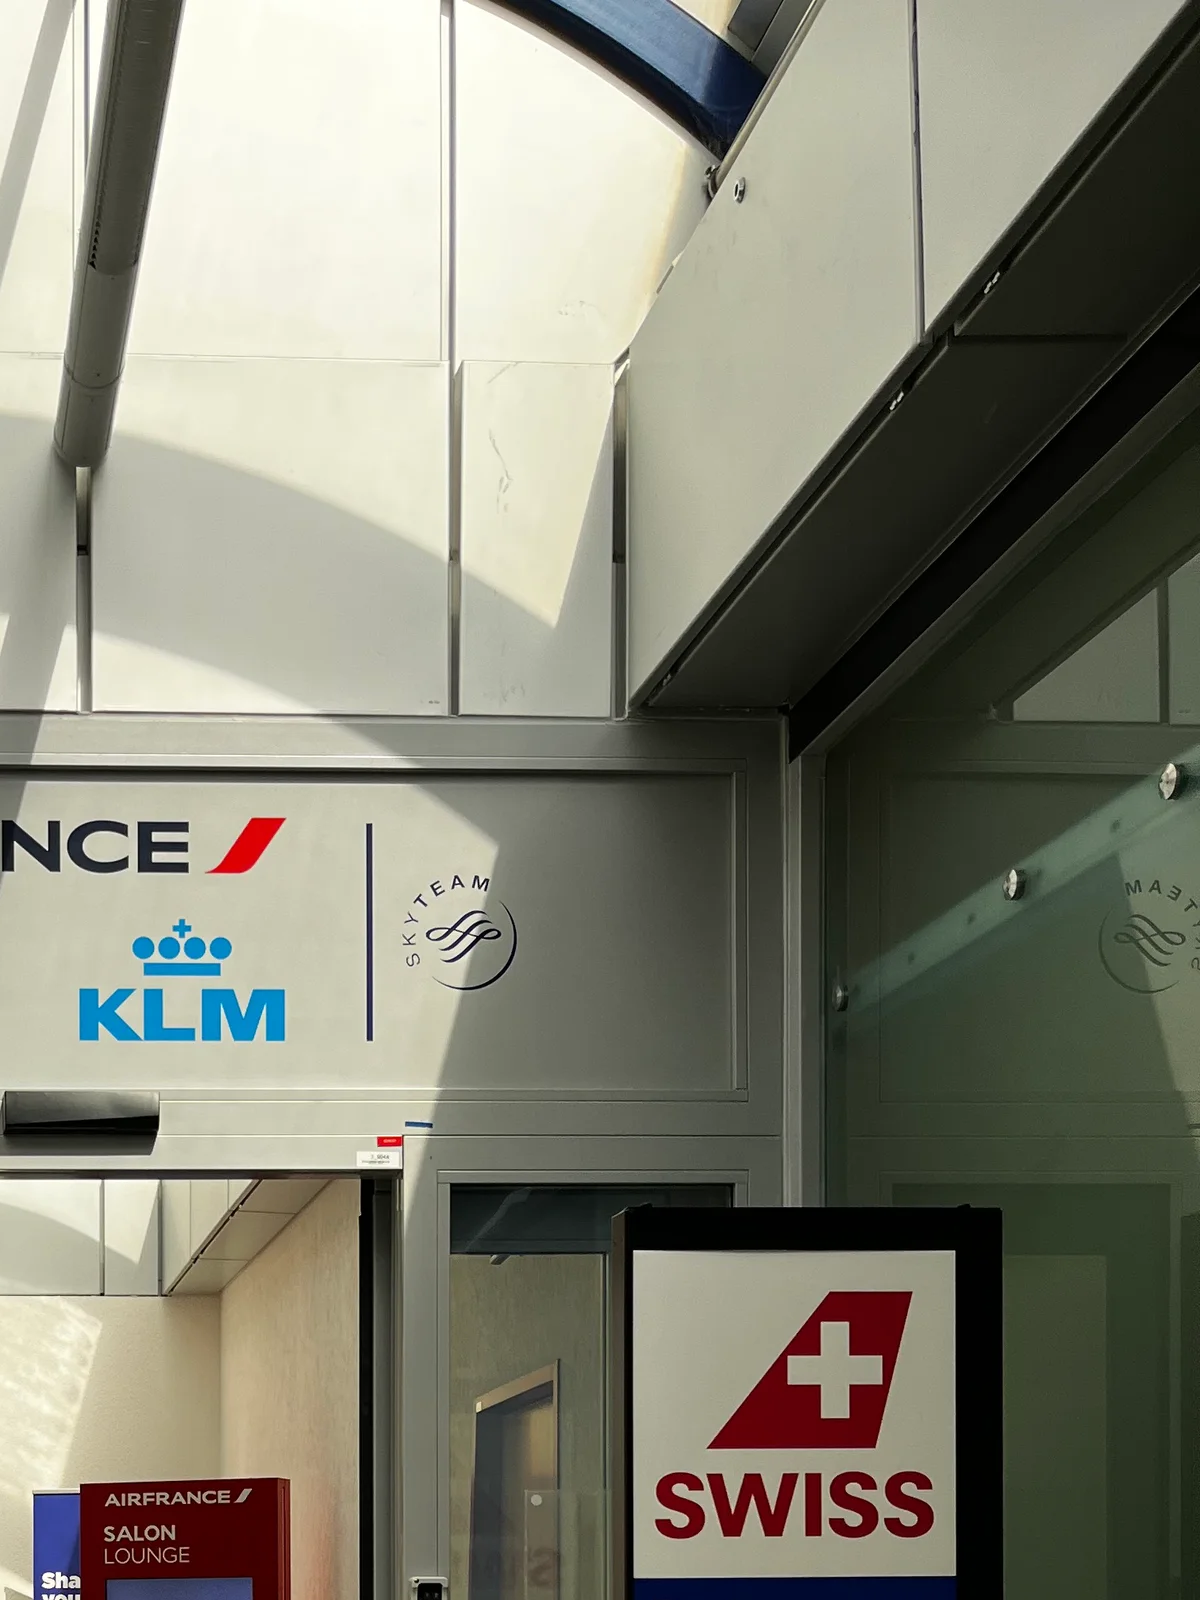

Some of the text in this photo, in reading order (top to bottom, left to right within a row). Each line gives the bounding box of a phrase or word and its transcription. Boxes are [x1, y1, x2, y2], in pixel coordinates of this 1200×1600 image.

[402, 874, 491, 968] SKYTEAM
[78, 988, 286, 1042] KLM
[104, 1490, 231, 1507] AIRFRANCE
[654, 1470, 936, 1541] SWISS
[103, 1525, 176, 1542] SALON
[104, 1547, 190, 1564] LOUNGE
